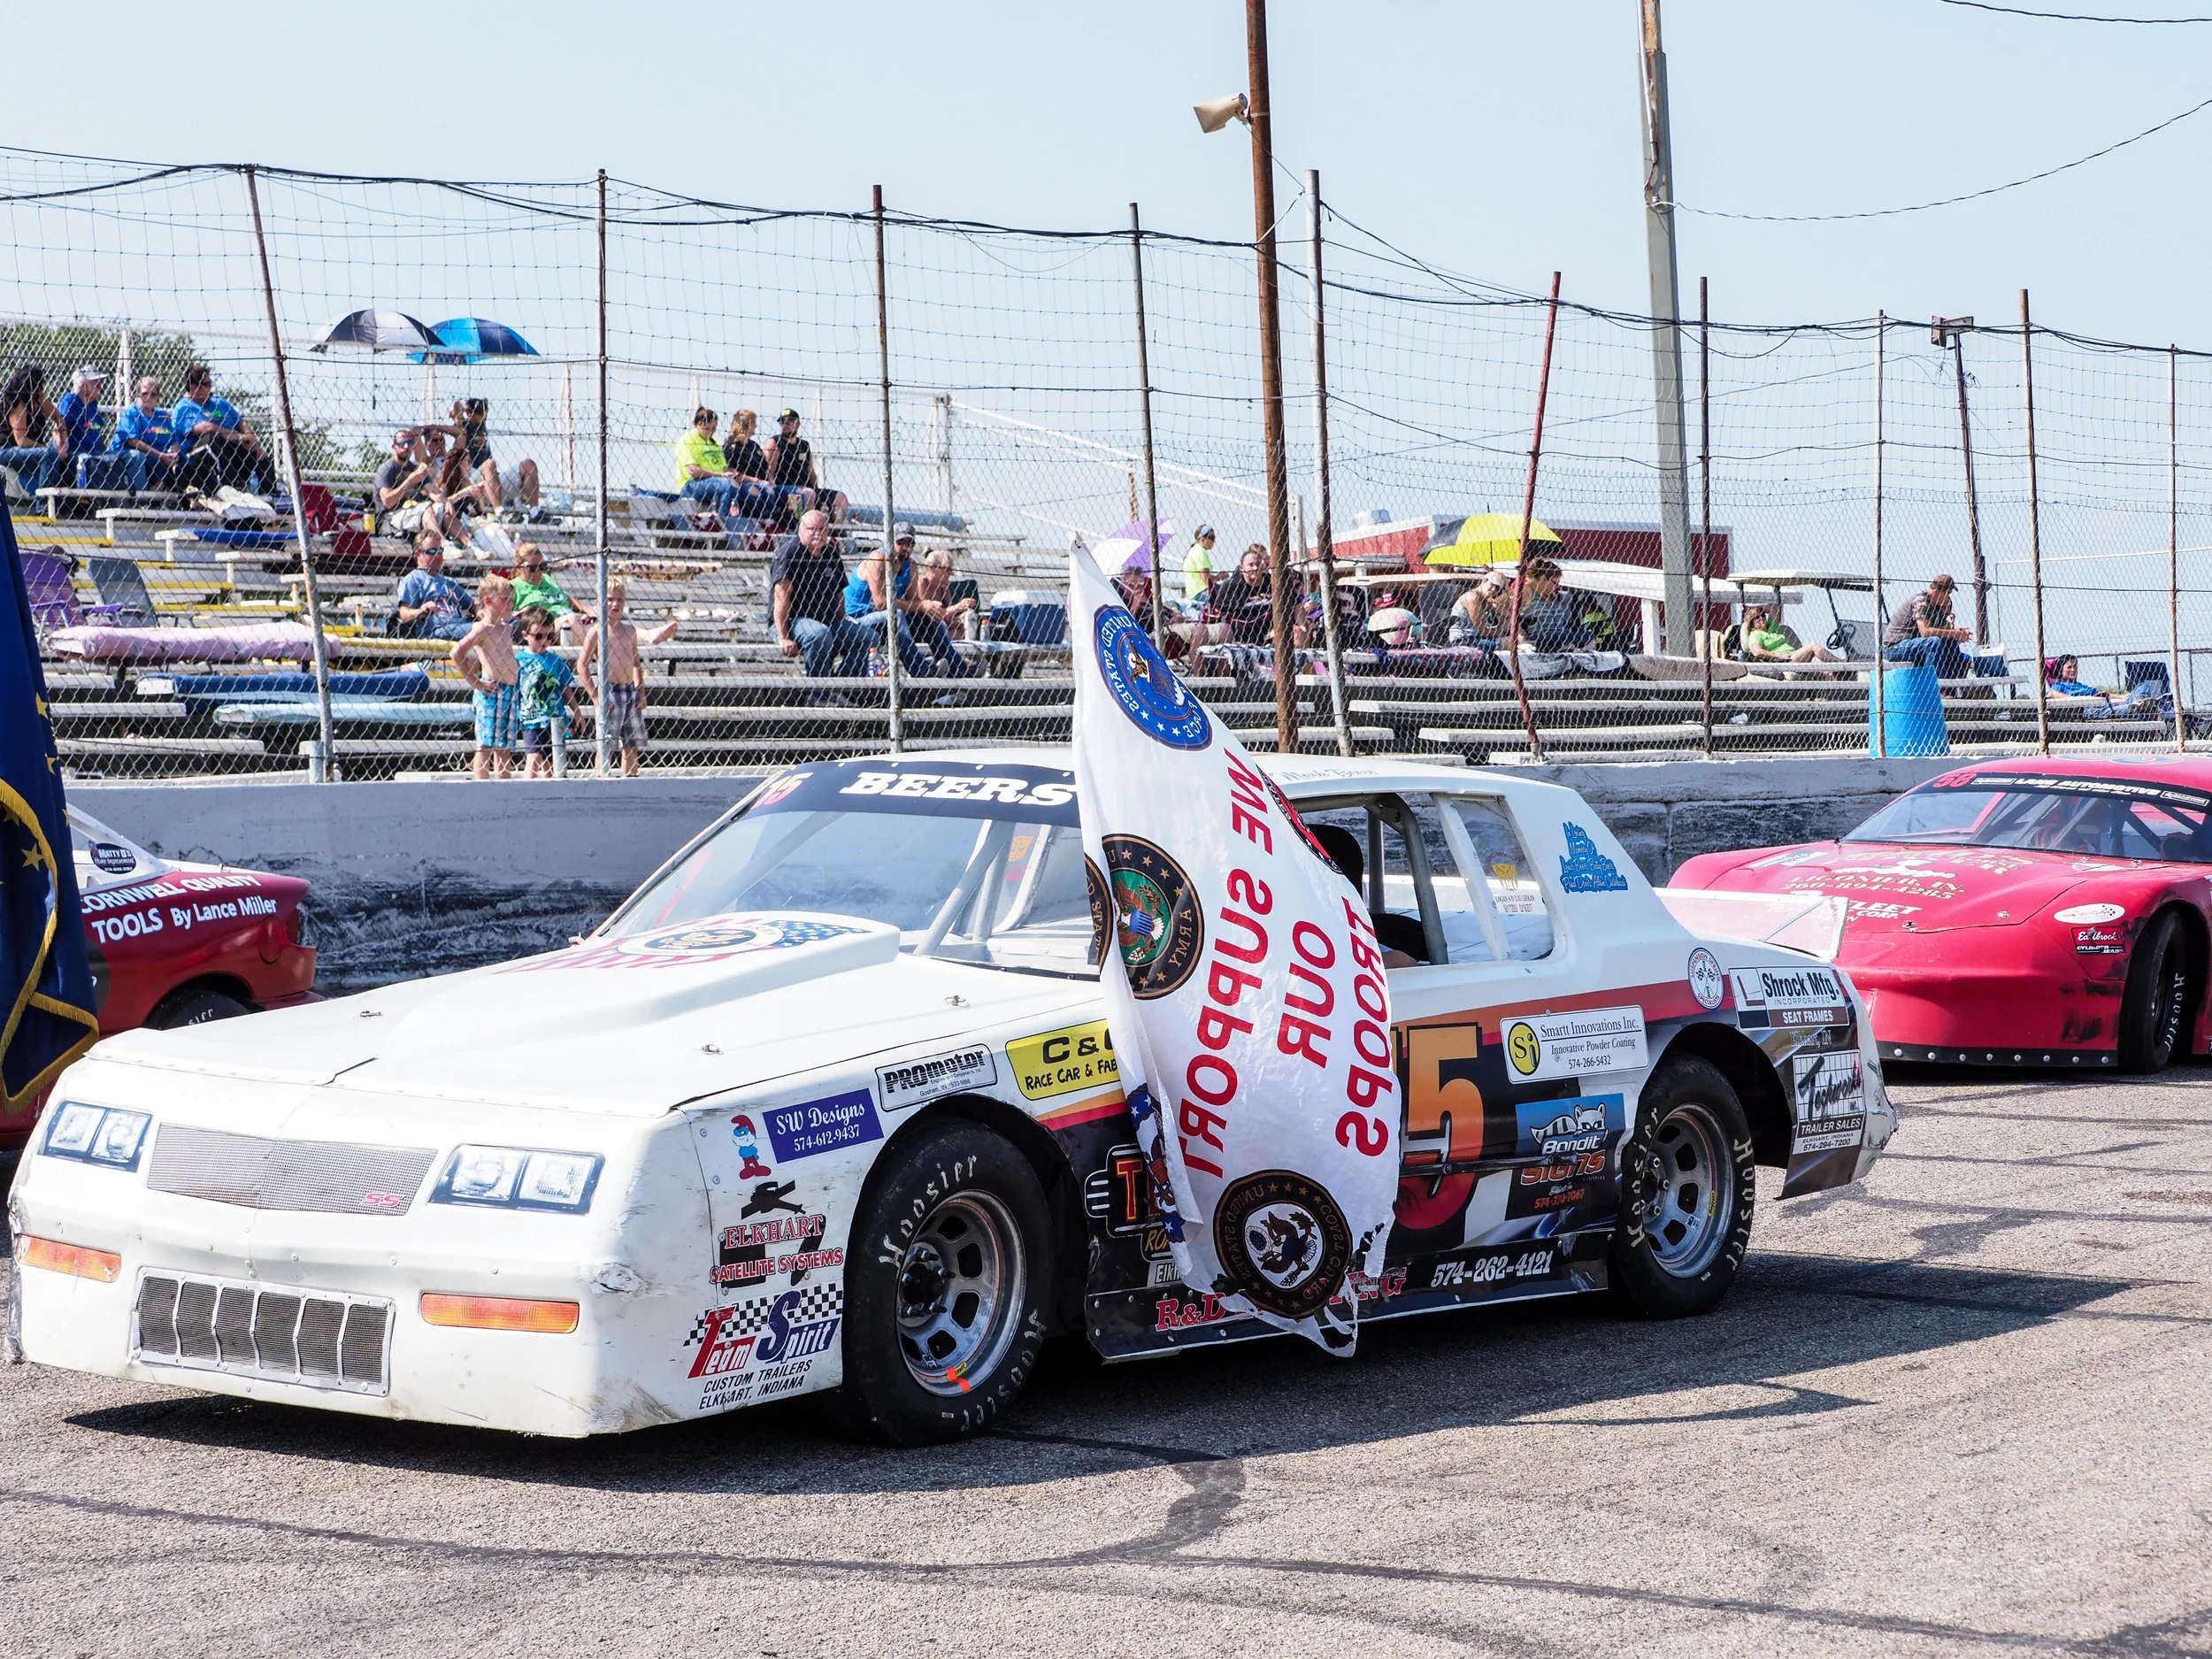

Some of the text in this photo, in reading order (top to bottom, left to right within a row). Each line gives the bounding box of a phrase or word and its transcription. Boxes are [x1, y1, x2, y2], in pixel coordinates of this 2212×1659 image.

[751, 772, 813, 810] 15
[839, 772, 1077, 806] BEERS
[1932, 772, 1978, 787] 58
[2059, 780, 2162, 795] AUTOMOTIVE
[180, 874, 262, 892] QUALITY
[91, 895, 277, 944] TOOLS By Lance Miller
[1762, 972, 1839, 1000] Shrock Mfg.
[1774, 996, 1831, 1006] INCORPORATED
[1540, 1016, 1639, 1038] Smartt Innovations Inc.
[1782, 1010, 1834, 1024] SEAT FRAMES
[1042, 1036, 1070, 1064] C
[1078, 1036, 1100, 1057] &
[1551, 1036, 1636, 1056] Innovative Powder Coating
[1568, 1055, 1611, 1070] 574-266-5432
[1025, 1071, 1053, 1091] RACE
[1056, 1066, 1080, 1084] CAR
[1085, 1063, 1094, 1078] &
[919, 1087, 941, 1097] Goshen,
[776, 1103, 865, 1136] SW Designs
[1391, 1026, 1484, 1229] 5
[1801, 1118, 1861, 1135] TRAILER SALES
[794, 1124, 861, 1152] 574-612-9437
[1541, 1135, 1601, 1155] Bandit
[1802, 1138, 1851, 1152] 574-294-7200
[360, 1192, 403, 1207] SS
[878, 1154, 977, 1269] Hoosier
[723, 1214, 824, 1250] ELKHART
[710, 1248, 844, 1284] SATELLITE SYSTEMS
[1431, 1250, 1554, 1288] 574-262-4121
[1155, 1292, 1227, 1331] R&D
[687, 1290, 834, 1379] Team Spirit
[703, 1359, 813, 1394] CUSTOM TRAILERS
[698, 1375, 805, 1410] ELKHART, INDIANA
